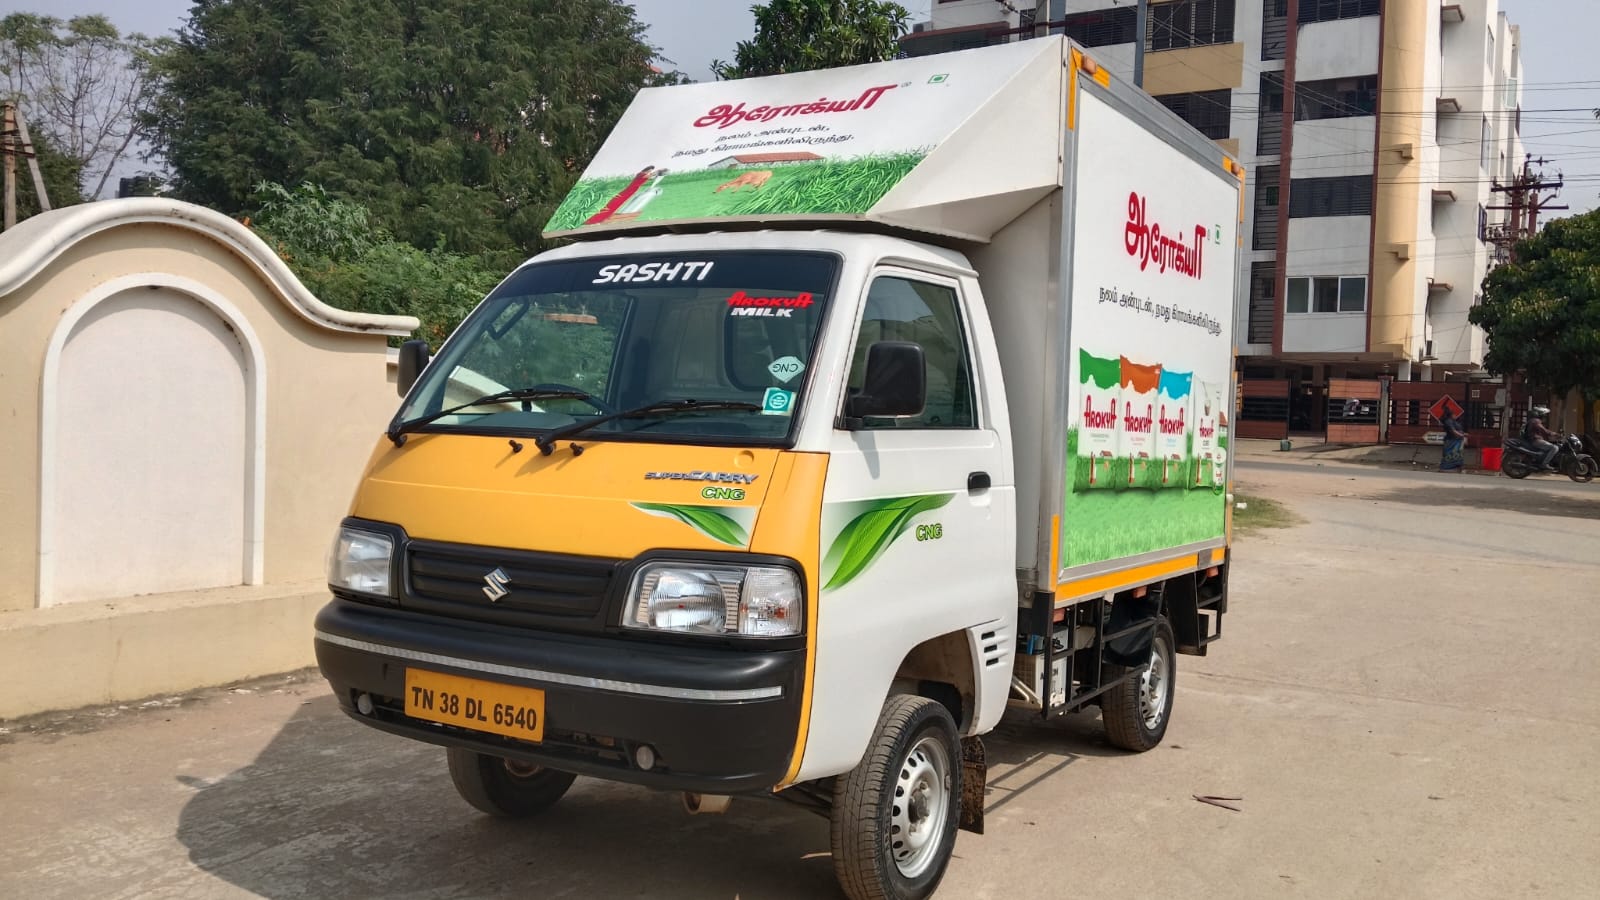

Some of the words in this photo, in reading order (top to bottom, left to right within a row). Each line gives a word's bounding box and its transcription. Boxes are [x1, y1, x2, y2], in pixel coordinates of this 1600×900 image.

[592, 261, 714, 284] SASHTI
[731, 307, 793, 318] MILK
[772, 363, 799, 373] CNG
[701, 486, 745, 500] CNG
[916, 524, 942, 541] CNG
[411, 686, 434, 710] TN
[439, 692, 459, 716] 38
[465, 697, 487, 722] DL
[493, 703, 537, 731] 6540
